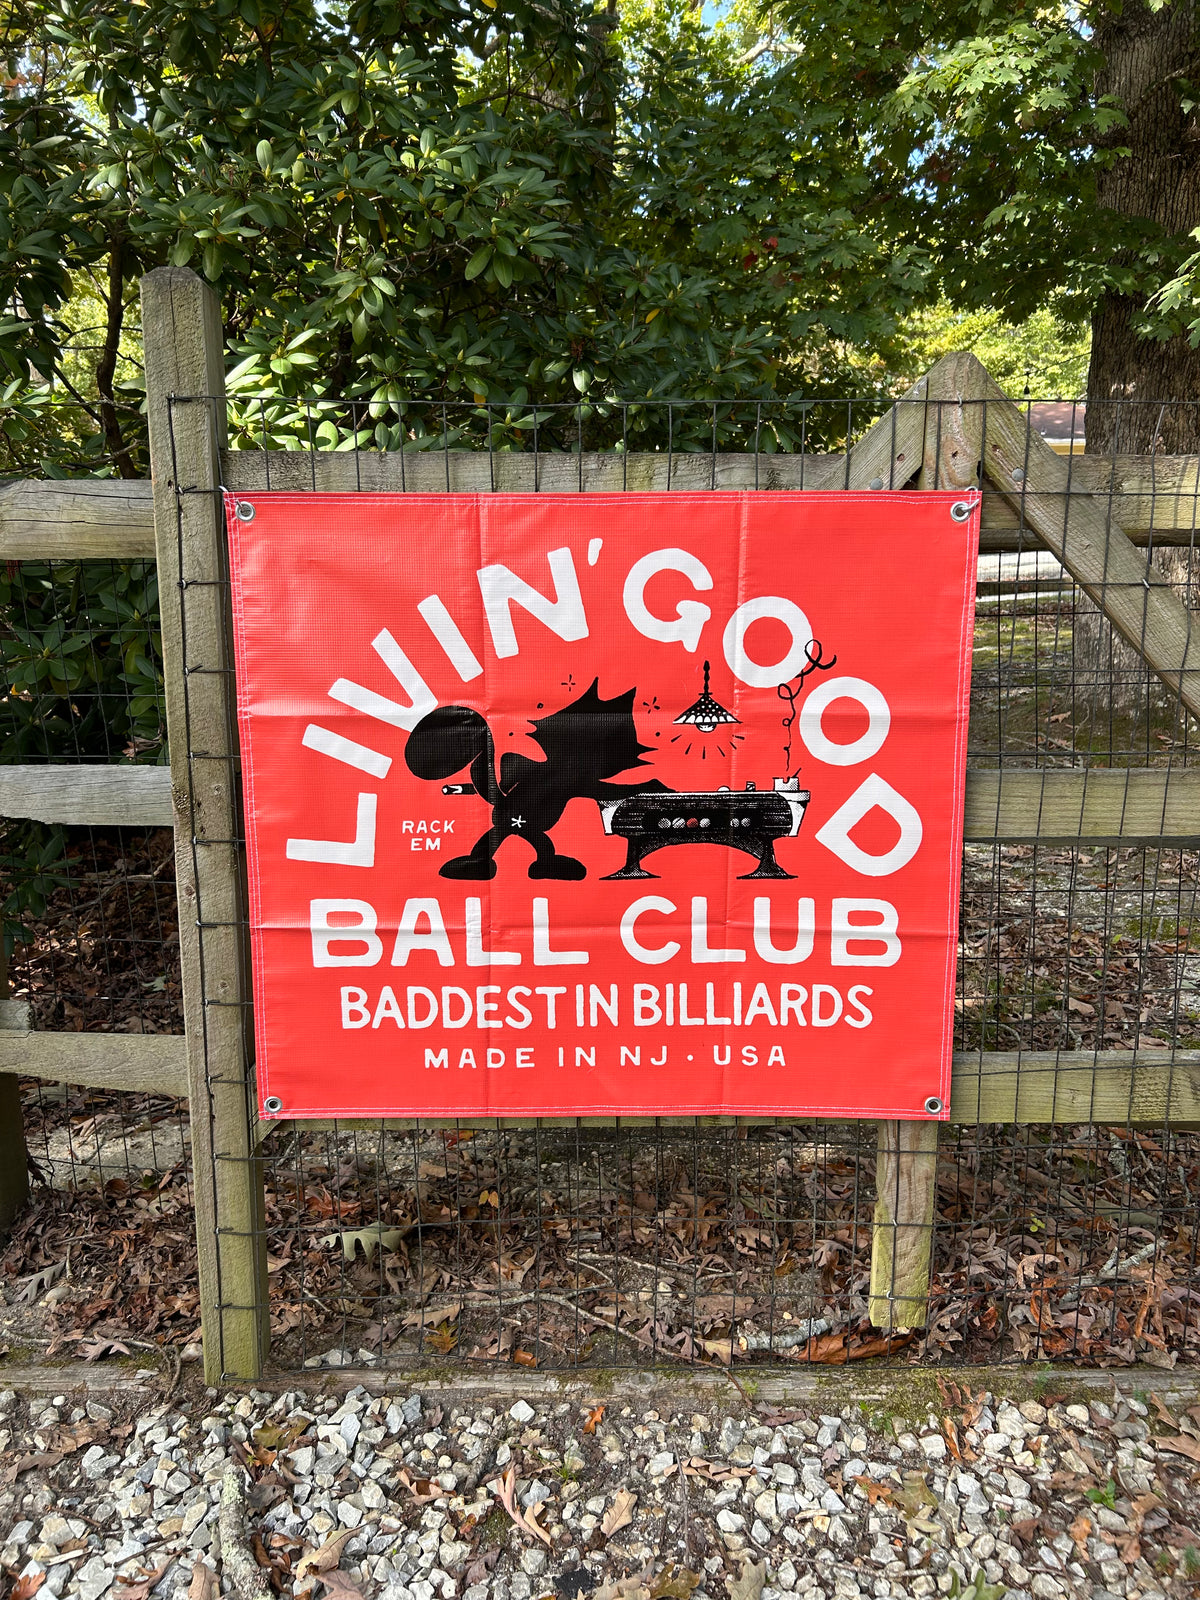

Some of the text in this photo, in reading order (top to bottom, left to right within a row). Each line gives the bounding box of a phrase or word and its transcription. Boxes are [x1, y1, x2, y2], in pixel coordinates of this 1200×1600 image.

[285, 537, 923, 877] LIVIN' GOOD
[401, 819, 456, 834] RACK
[410, 837, 441, 851] EM
[310, 895, 902, 968] BALL CLUB
[340, 981, 874, 1030] BADDEST IN BILLIARDS
[424, 1044, 786, 1069] MADE IN NJ USA
